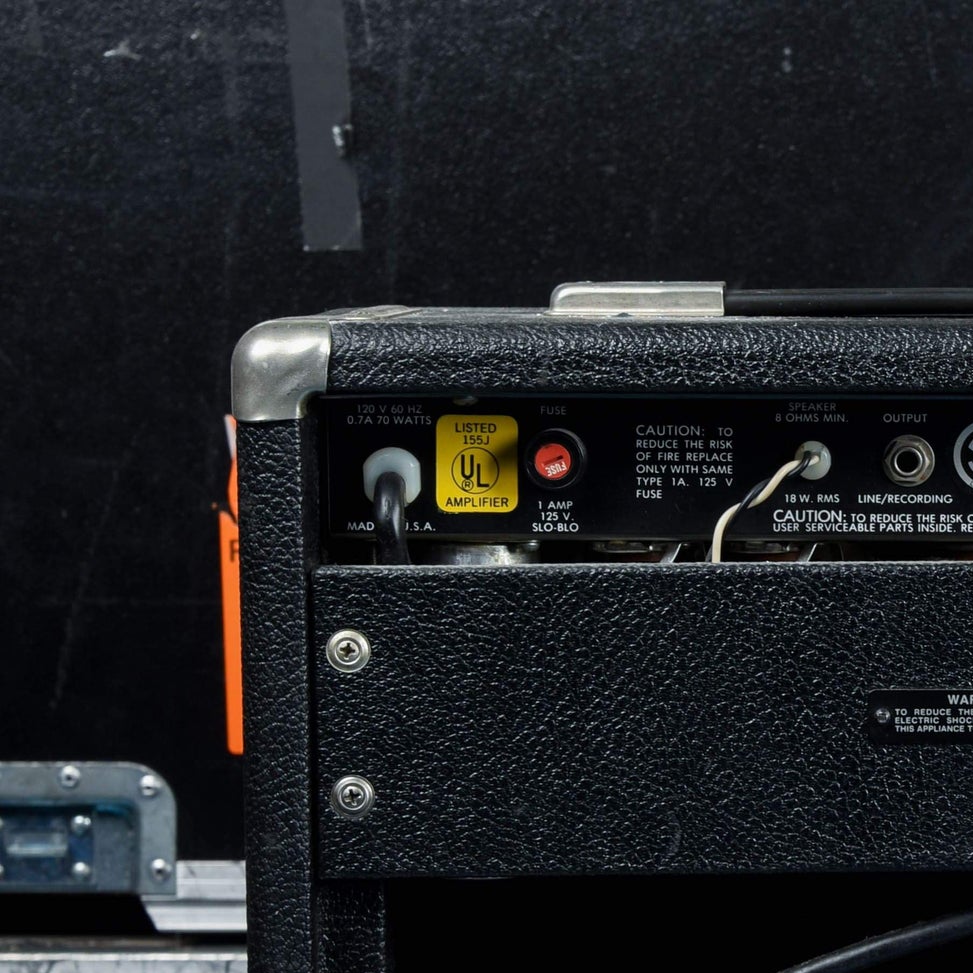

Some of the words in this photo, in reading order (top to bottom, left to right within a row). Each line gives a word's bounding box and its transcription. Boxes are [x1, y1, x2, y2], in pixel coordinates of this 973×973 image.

[357, 404, 375, 414] 120
[379, 404, 387, 414] V
[391, 404, 404, 414] 60
[408, 404, 424, 414] HZ
[540, 406, 567, 415] FUSE
[789, 402, 836, 411] SPEAKER
[347, 416, 373, 426] 0.7A
[376, 416, 390, 426] 70
[393, 416, 432, 426] WATTS
[776, 413, 782, 423] 8
[786, 413, 819, 423] OHMS
[823, 413, 849, 423] MIN.
[883, 414, 928, 423] OUTPUT
[455, 423, 497, 433] LISTED
[636, 424, 705, 437] CAUTION:
[719, 427, 734, 436] TO
[463, 435, 490, 446] 155J
[636, 440, 678, 449] REDUCE
[684, 440, 704, 449] THE
[710, 440, 734, 449] RISK
[636, 453, 651, 462] OF
[657, 453, 680, 462] FIRE
[686, 453, 734, 462] REPLACE
[461, 455, 490, 488] UL
[545, 461, 567, 477] FUSE
[636, 465, 667, 474] ONLY
[670, 465, 699, 474] WITH
[702, 465, 734, 474] SAME
[636, 478, 662, 487] TYPE
[672, 478, 690, 487] 1A.
[700, 478, 717, 487] 125
[726, 478, 734, 487] V
[636, 490, 663, 499] FUSE
[785, 493, 796, 504] 18
[799, 493, 813, 504] W.
[817, 493, 840, 504] RMS
[858, 493, 953, 505] LINE/RECORDING
[445, 498, 509, 508] AMPLIFIER
[538, 501, 543, 510] 1
[548, 501, 573, 510] AMP
[541, 512, 560, 521] 125
[563, 512, 575, 521] V.
[773, 509, 847, 523] CAUTION:
[851, 514, 866, 523] TO
[870, 514, 912, 523] REDUCE
[916, 514, 936, 523] THE
[939, 514, 963, 523] RISK
[347, 522, 375, 532] MAD
[532, 523, 579, 532] SLO-BLO
[773, 523, 800, 533] USER
[805, 523, 876, 533] SERVICEABLE
[880, 523, 914, 533] PARTS
[918, 523, 957, 533] INSIDE.
[895, 708, 908, 716] TO
[914, 708, 952, 716] REDUCE
[895, 725, 915, 733] THIS
[917, 725, 965, 733] APPLIANCE
